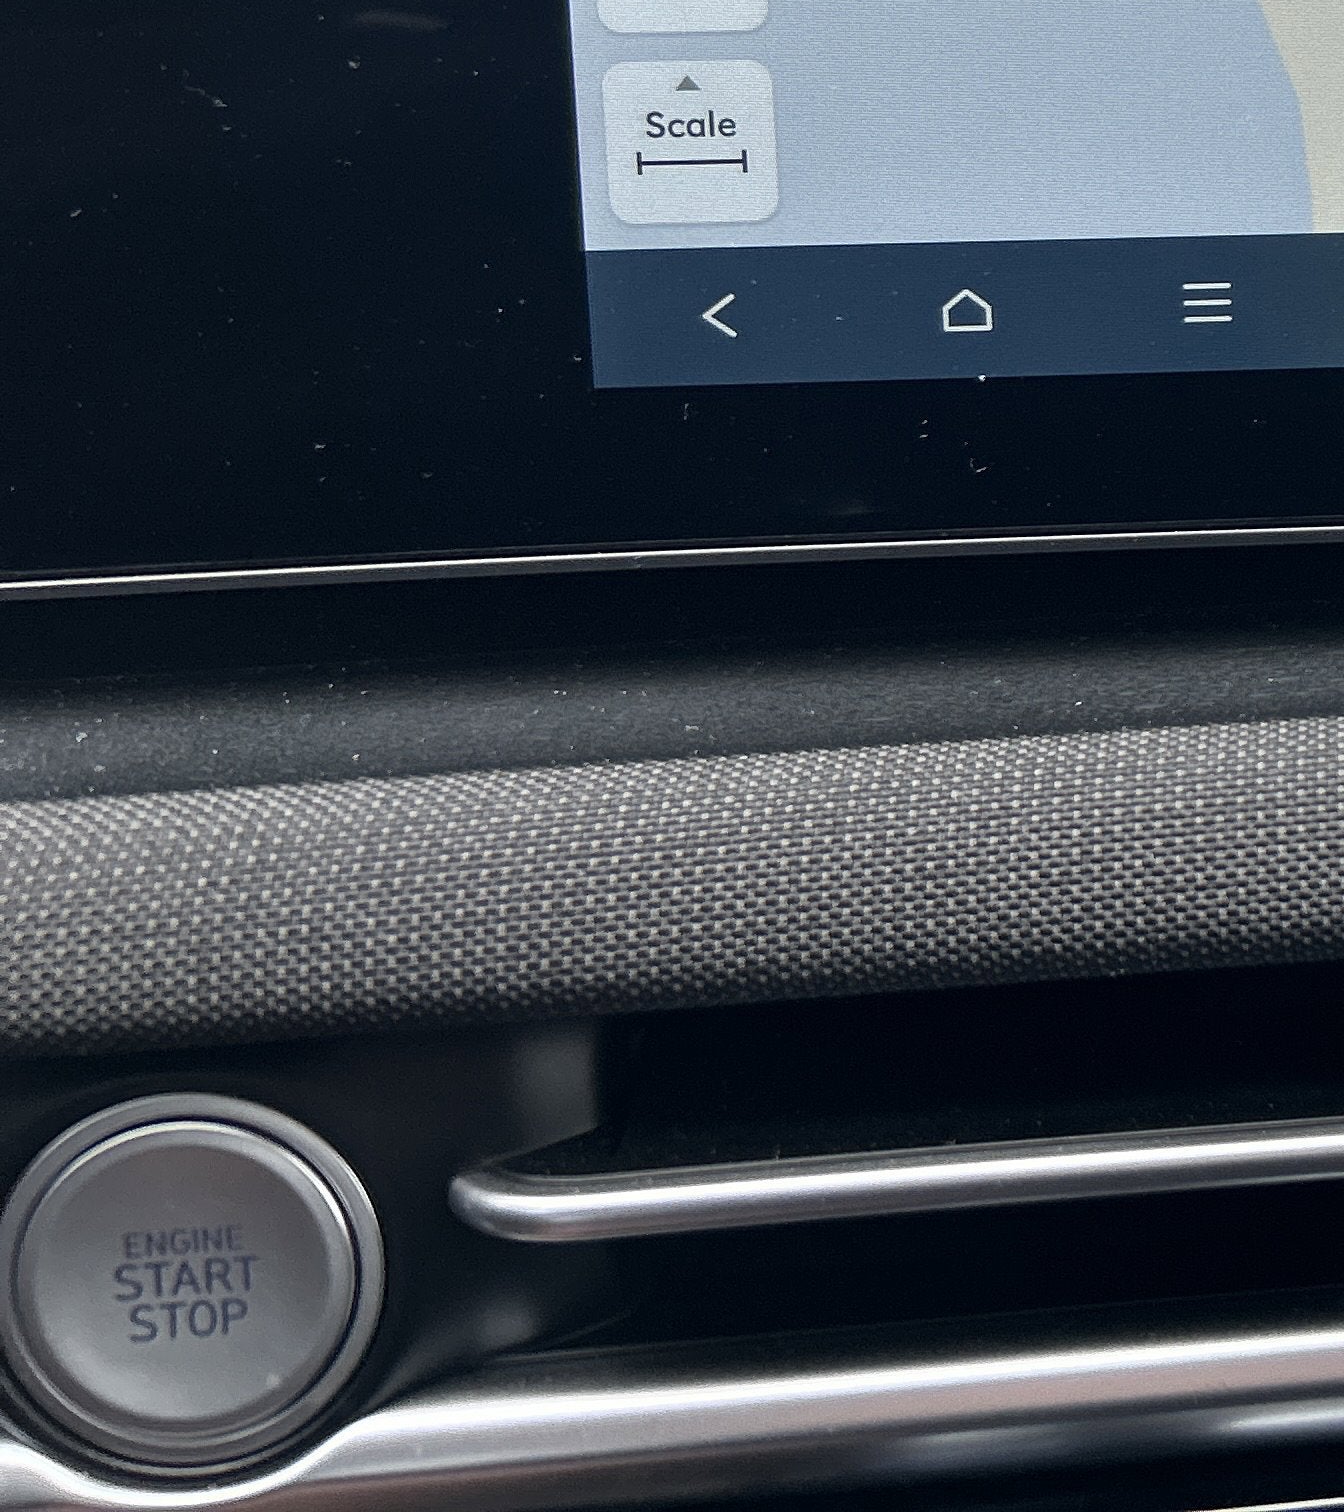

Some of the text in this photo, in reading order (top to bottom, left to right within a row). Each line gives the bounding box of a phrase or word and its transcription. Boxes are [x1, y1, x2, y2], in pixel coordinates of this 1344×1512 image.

[645, 109, 737, 139] Scale
[124, 1225, 243, 1259] ENGINE
[113, 1255, 260, 1302] START
[129, 1297, 249, 1344] STOP
